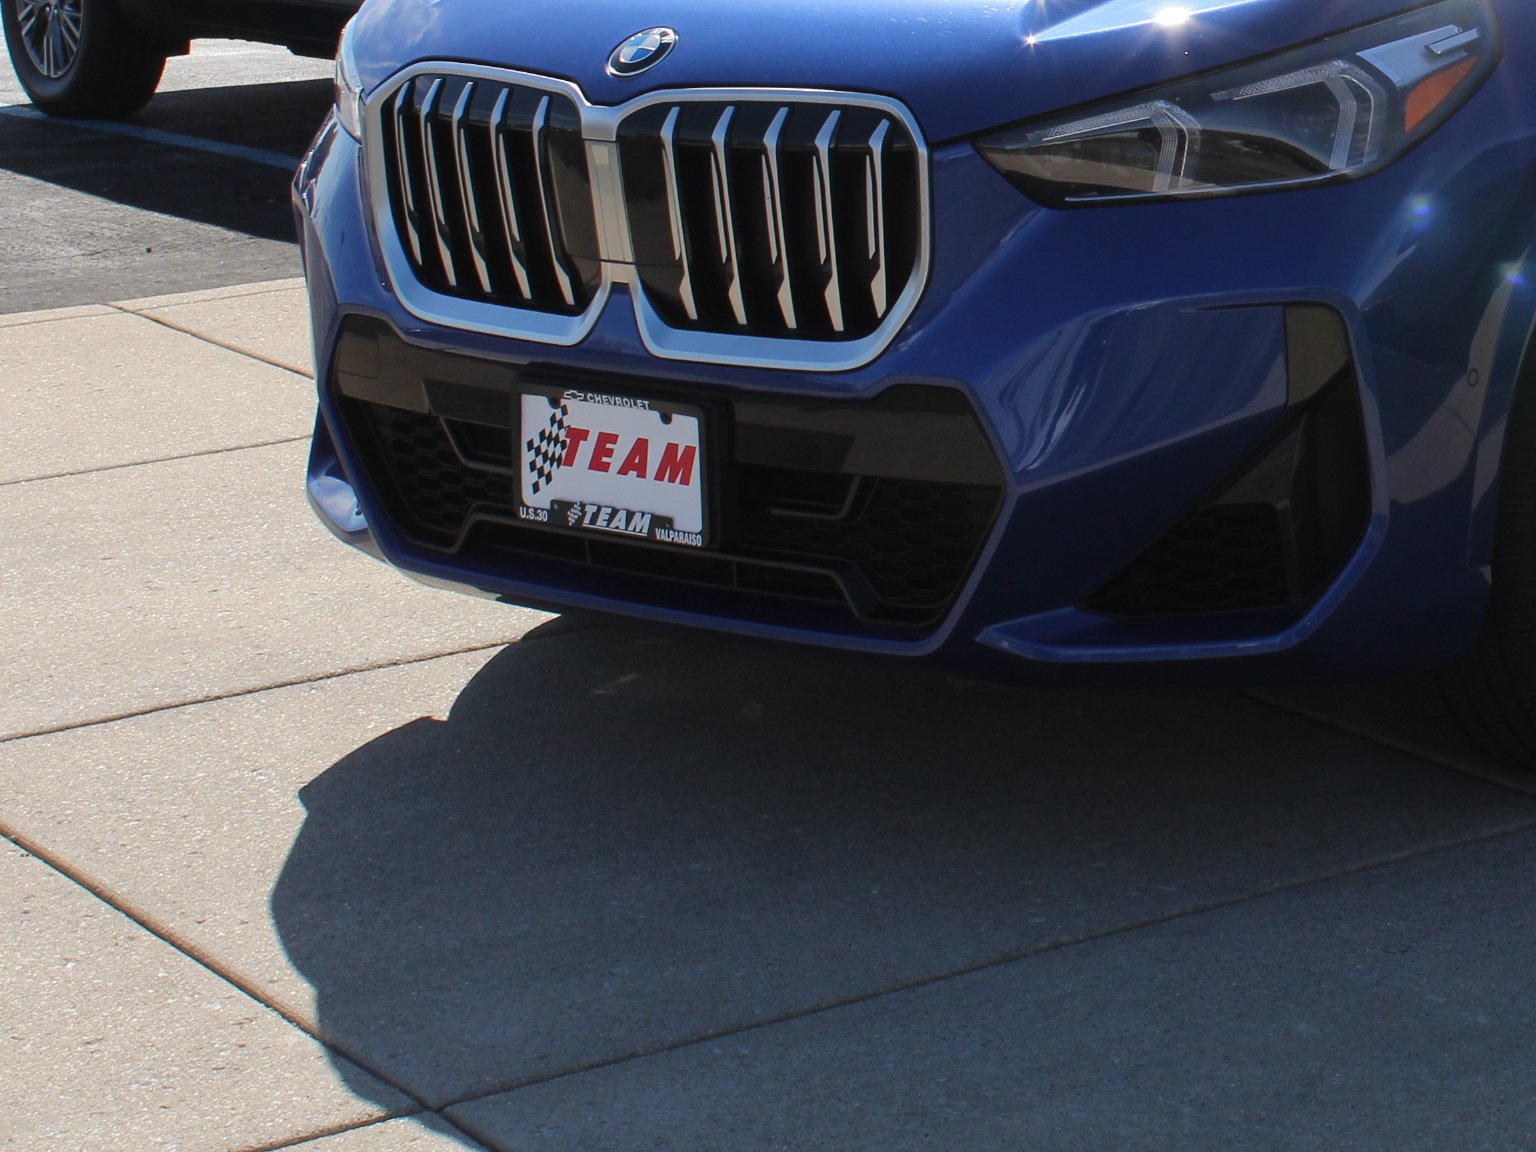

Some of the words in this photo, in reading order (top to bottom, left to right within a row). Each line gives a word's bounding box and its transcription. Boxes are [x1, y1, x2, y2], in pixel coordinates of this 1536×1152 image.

[587, 392, 650, 410] CHEVROLET
[562, 426, 697, 486] TEAM
[583, 504, 652, 534] TEAM
[655, 527, 702, 546] VALPARAISO
